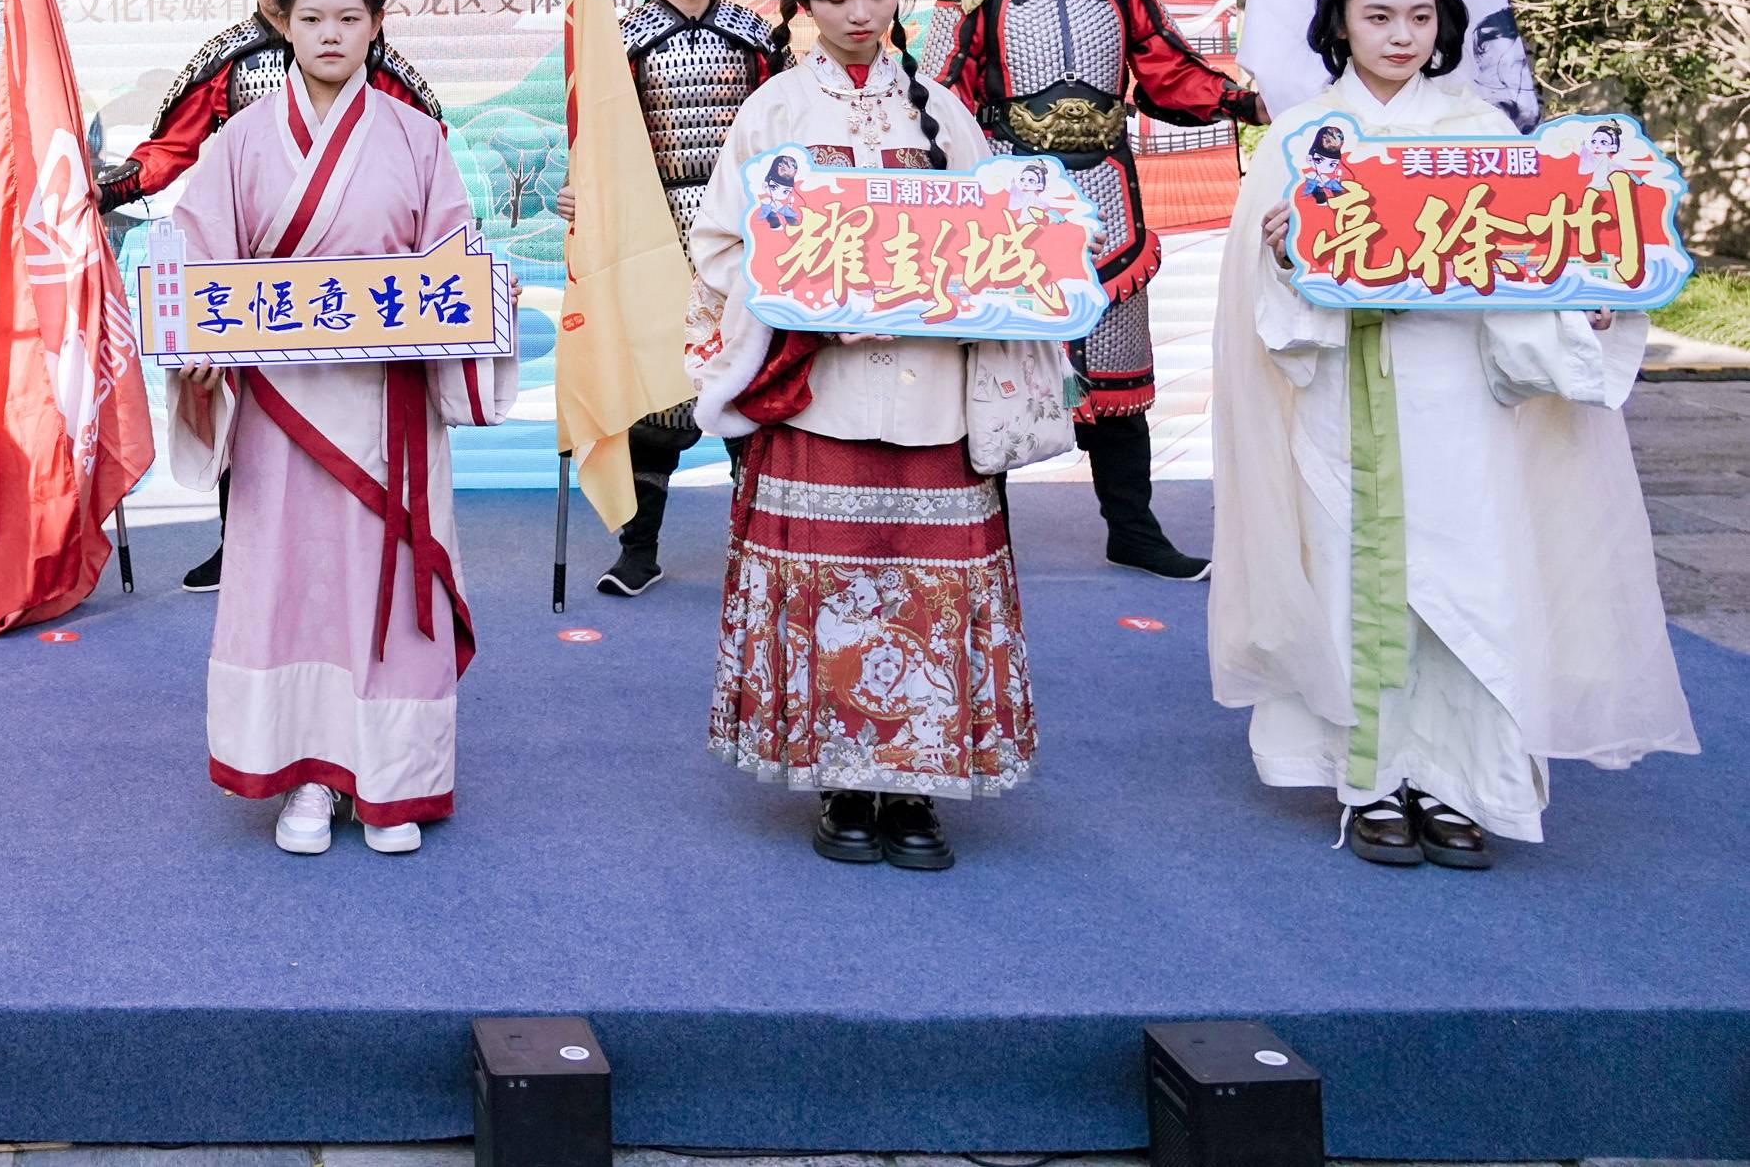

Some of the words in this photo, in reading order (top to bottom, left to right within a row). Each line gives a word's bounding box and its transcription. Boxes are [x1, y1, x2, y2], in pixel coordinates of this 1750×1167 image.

[866, 177, 985, 207] 国潮汉风
[1401, 147, 1540, 177] 美美汉服
[776, 202, 1069, 322] 耀彭城
[1312, 171, 1646, 293] 亮徐州
